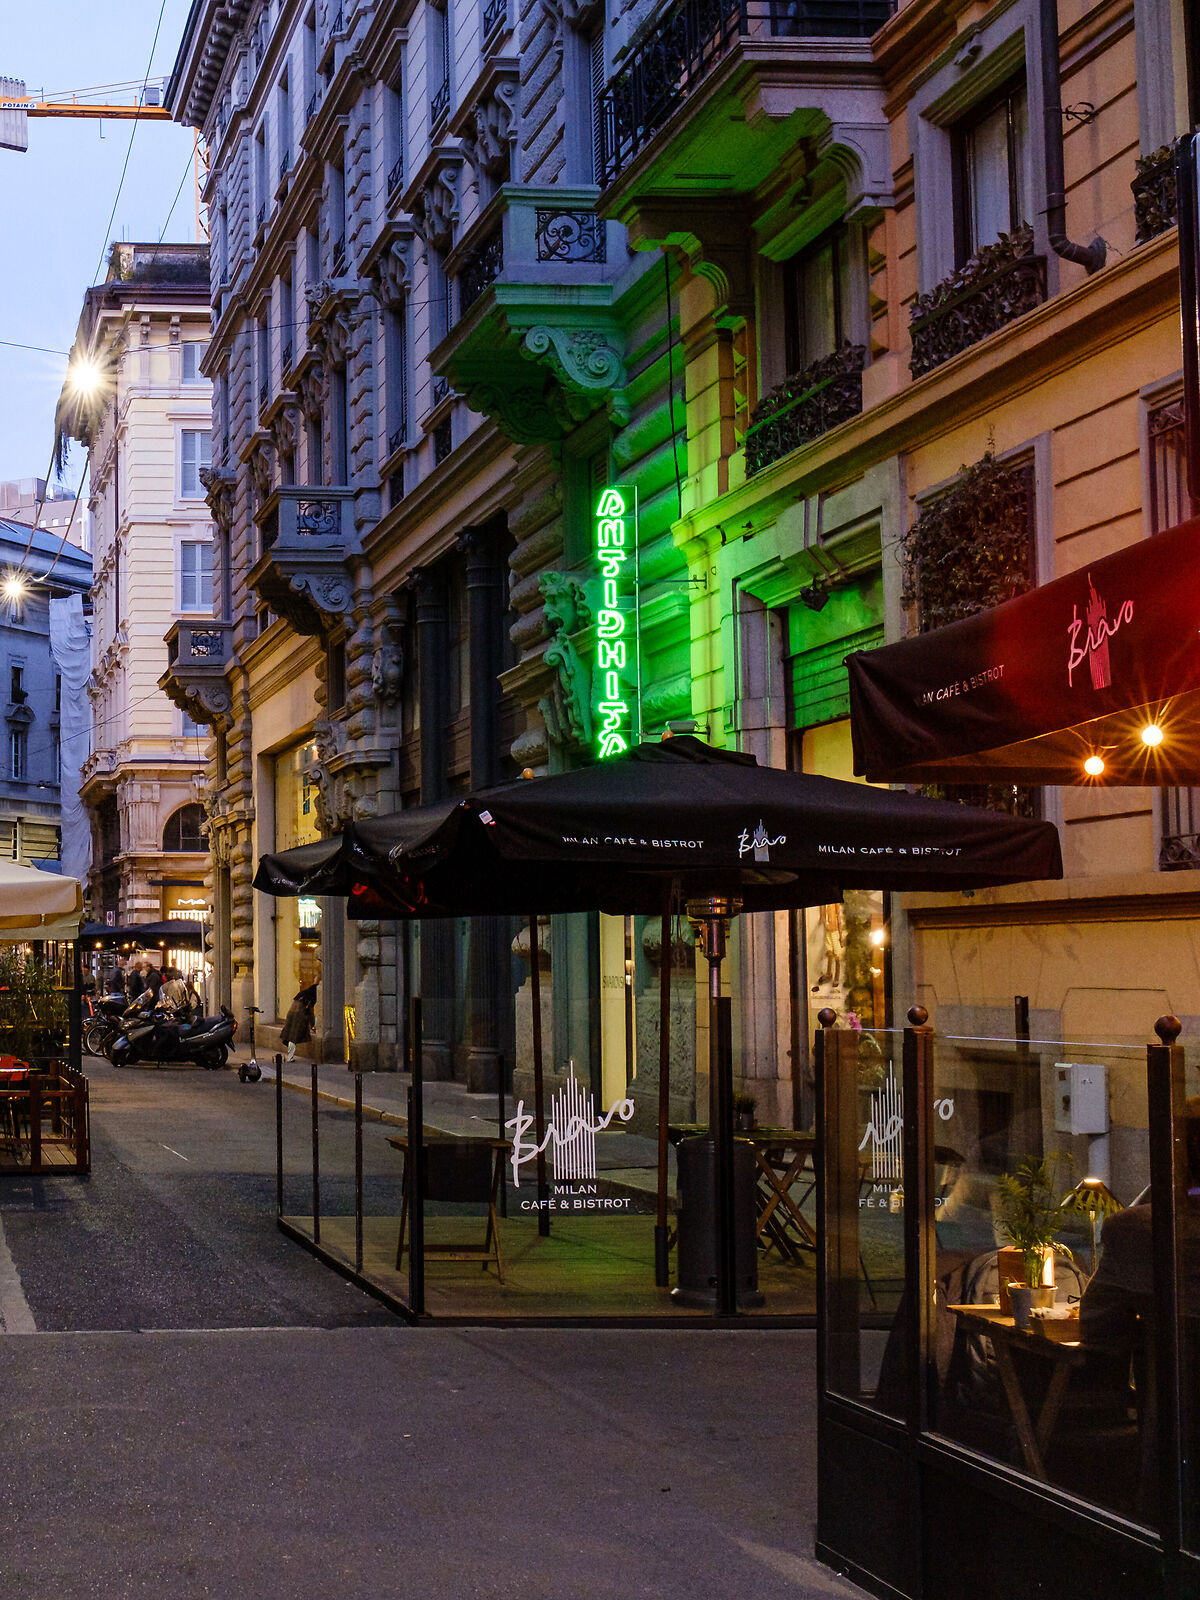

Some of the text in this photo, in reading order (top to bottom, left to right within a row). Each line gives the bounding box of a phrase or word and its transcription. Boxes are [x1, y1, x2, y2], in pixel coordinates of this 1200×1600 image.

[1068, 600, 1134, 687] Bravo
[936, 681, 960, 701] CAFÉ
[962, 681, 969, 692] &
[970, 664, 1005, 690] BISTROT
[652, 839, 705, 849] BISTROT
[738, 828, 786, 858] Bravo
[818, 844, 856, 855] MILAN
[504, 1098, 635, 1188] Bravo
[554, 1184, 597, 1195] MILAN
[873, 1183, 904, 1193] MILA
[521, 1197, 631, 1210] CAFÉ & BISTROT
[879, 1199, 887, 1208] &
